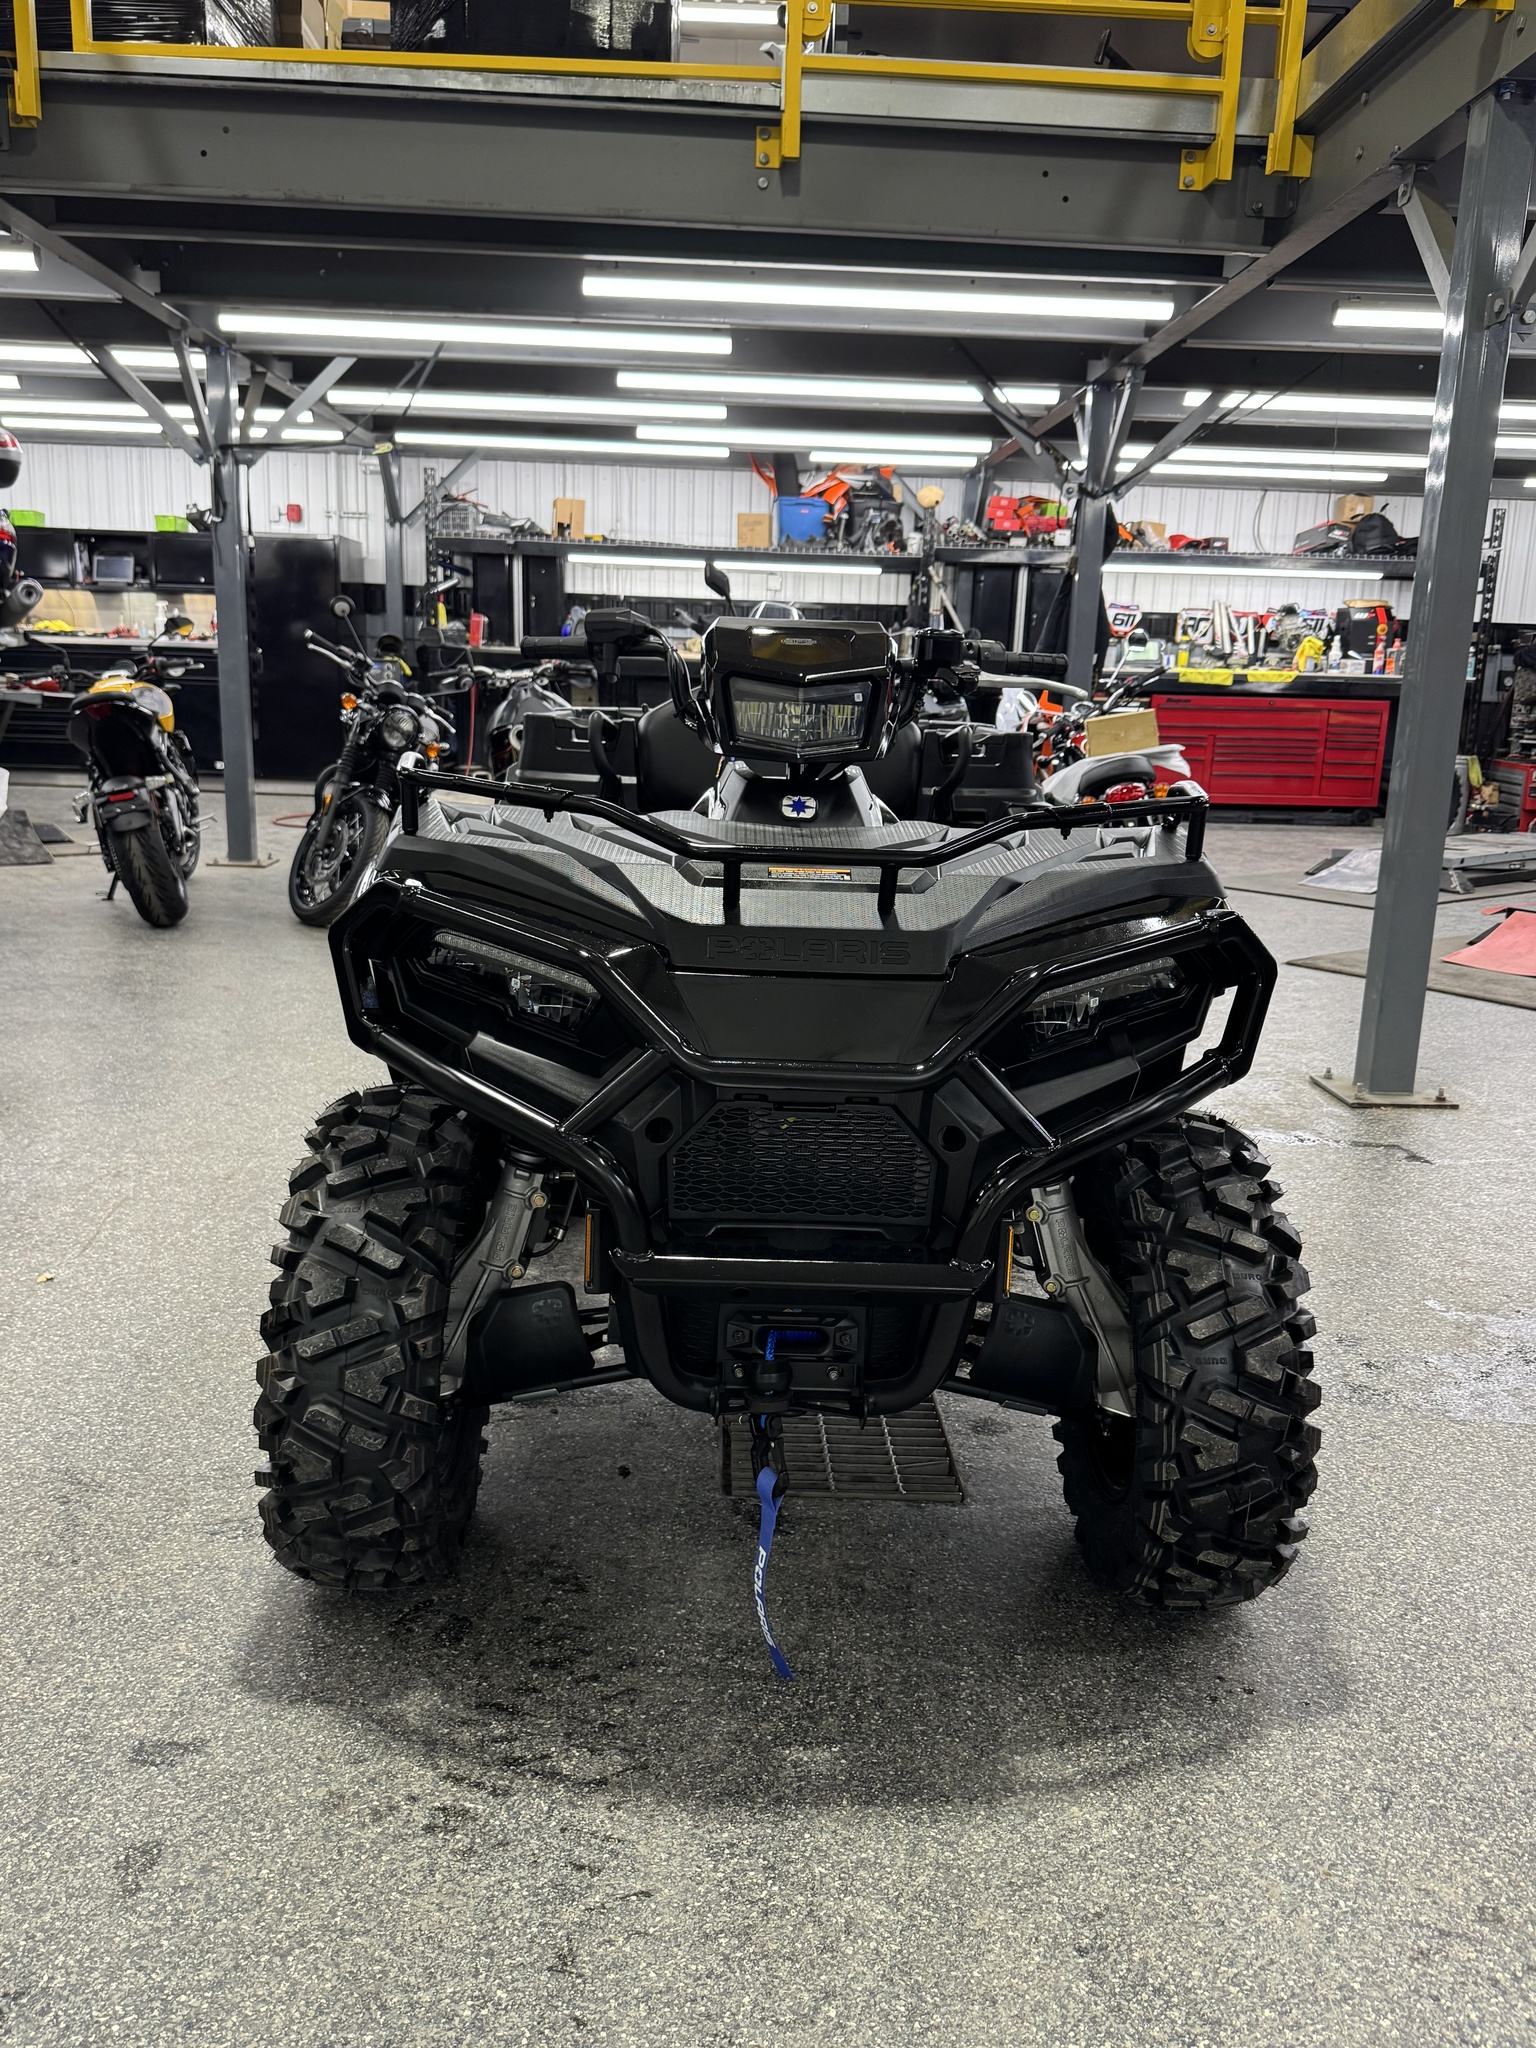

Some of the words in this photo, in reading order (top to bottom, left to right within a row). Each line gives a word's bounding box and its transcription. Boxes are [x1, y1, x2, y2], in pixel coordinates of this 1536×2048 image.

[707, 935, 911, 965] POLARIS
[493, 1203, 517, 1261] POLARIS
[1055, 1218, 1077, 1277] POLARIS
[754, 1545, 777, 1649] POLARIS
